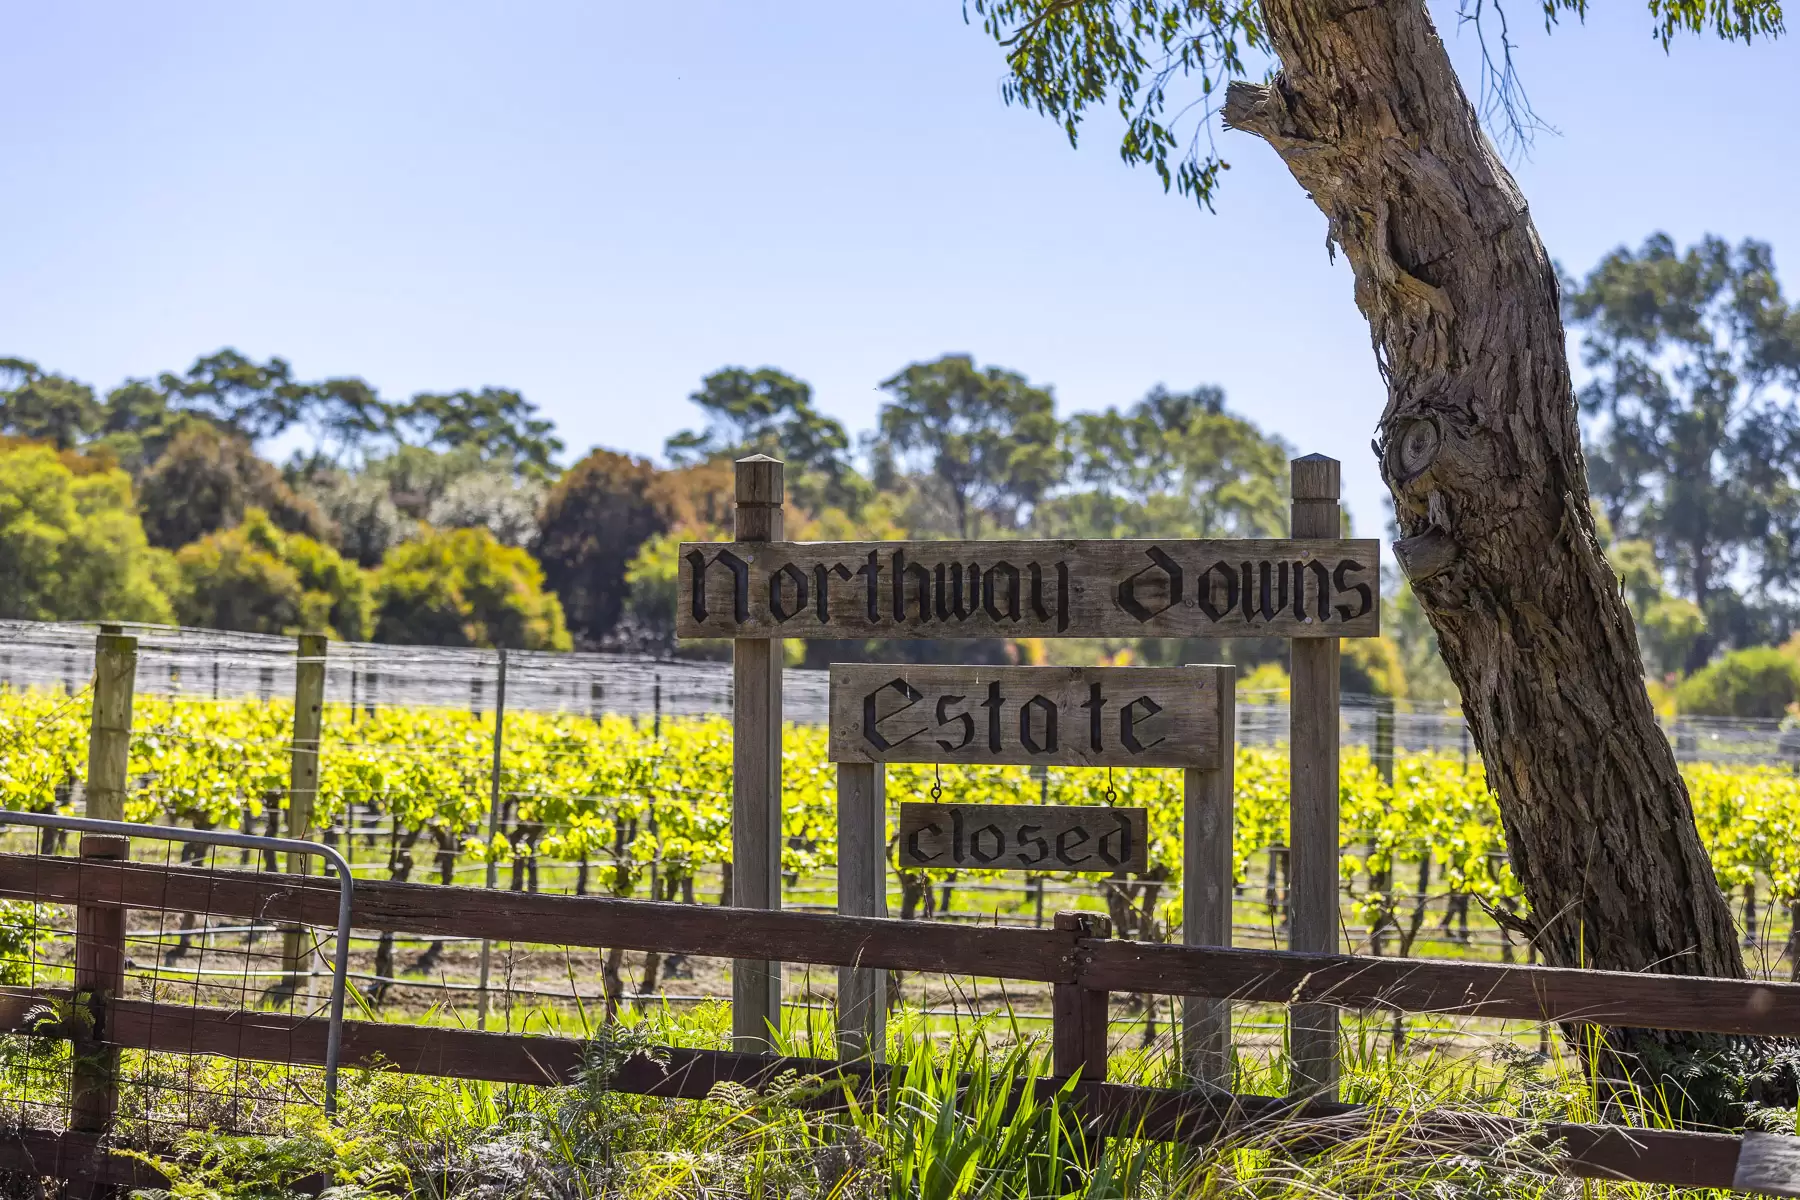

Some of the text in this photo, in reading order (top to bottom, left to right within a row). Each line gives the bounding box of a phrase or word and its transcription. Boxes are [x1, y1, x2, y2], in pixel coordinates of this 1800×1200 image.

[686, 548, 1069, 633] Northway
[863, 677, 1166, 755] Estate
[908, 807, 1132, 866] closed
